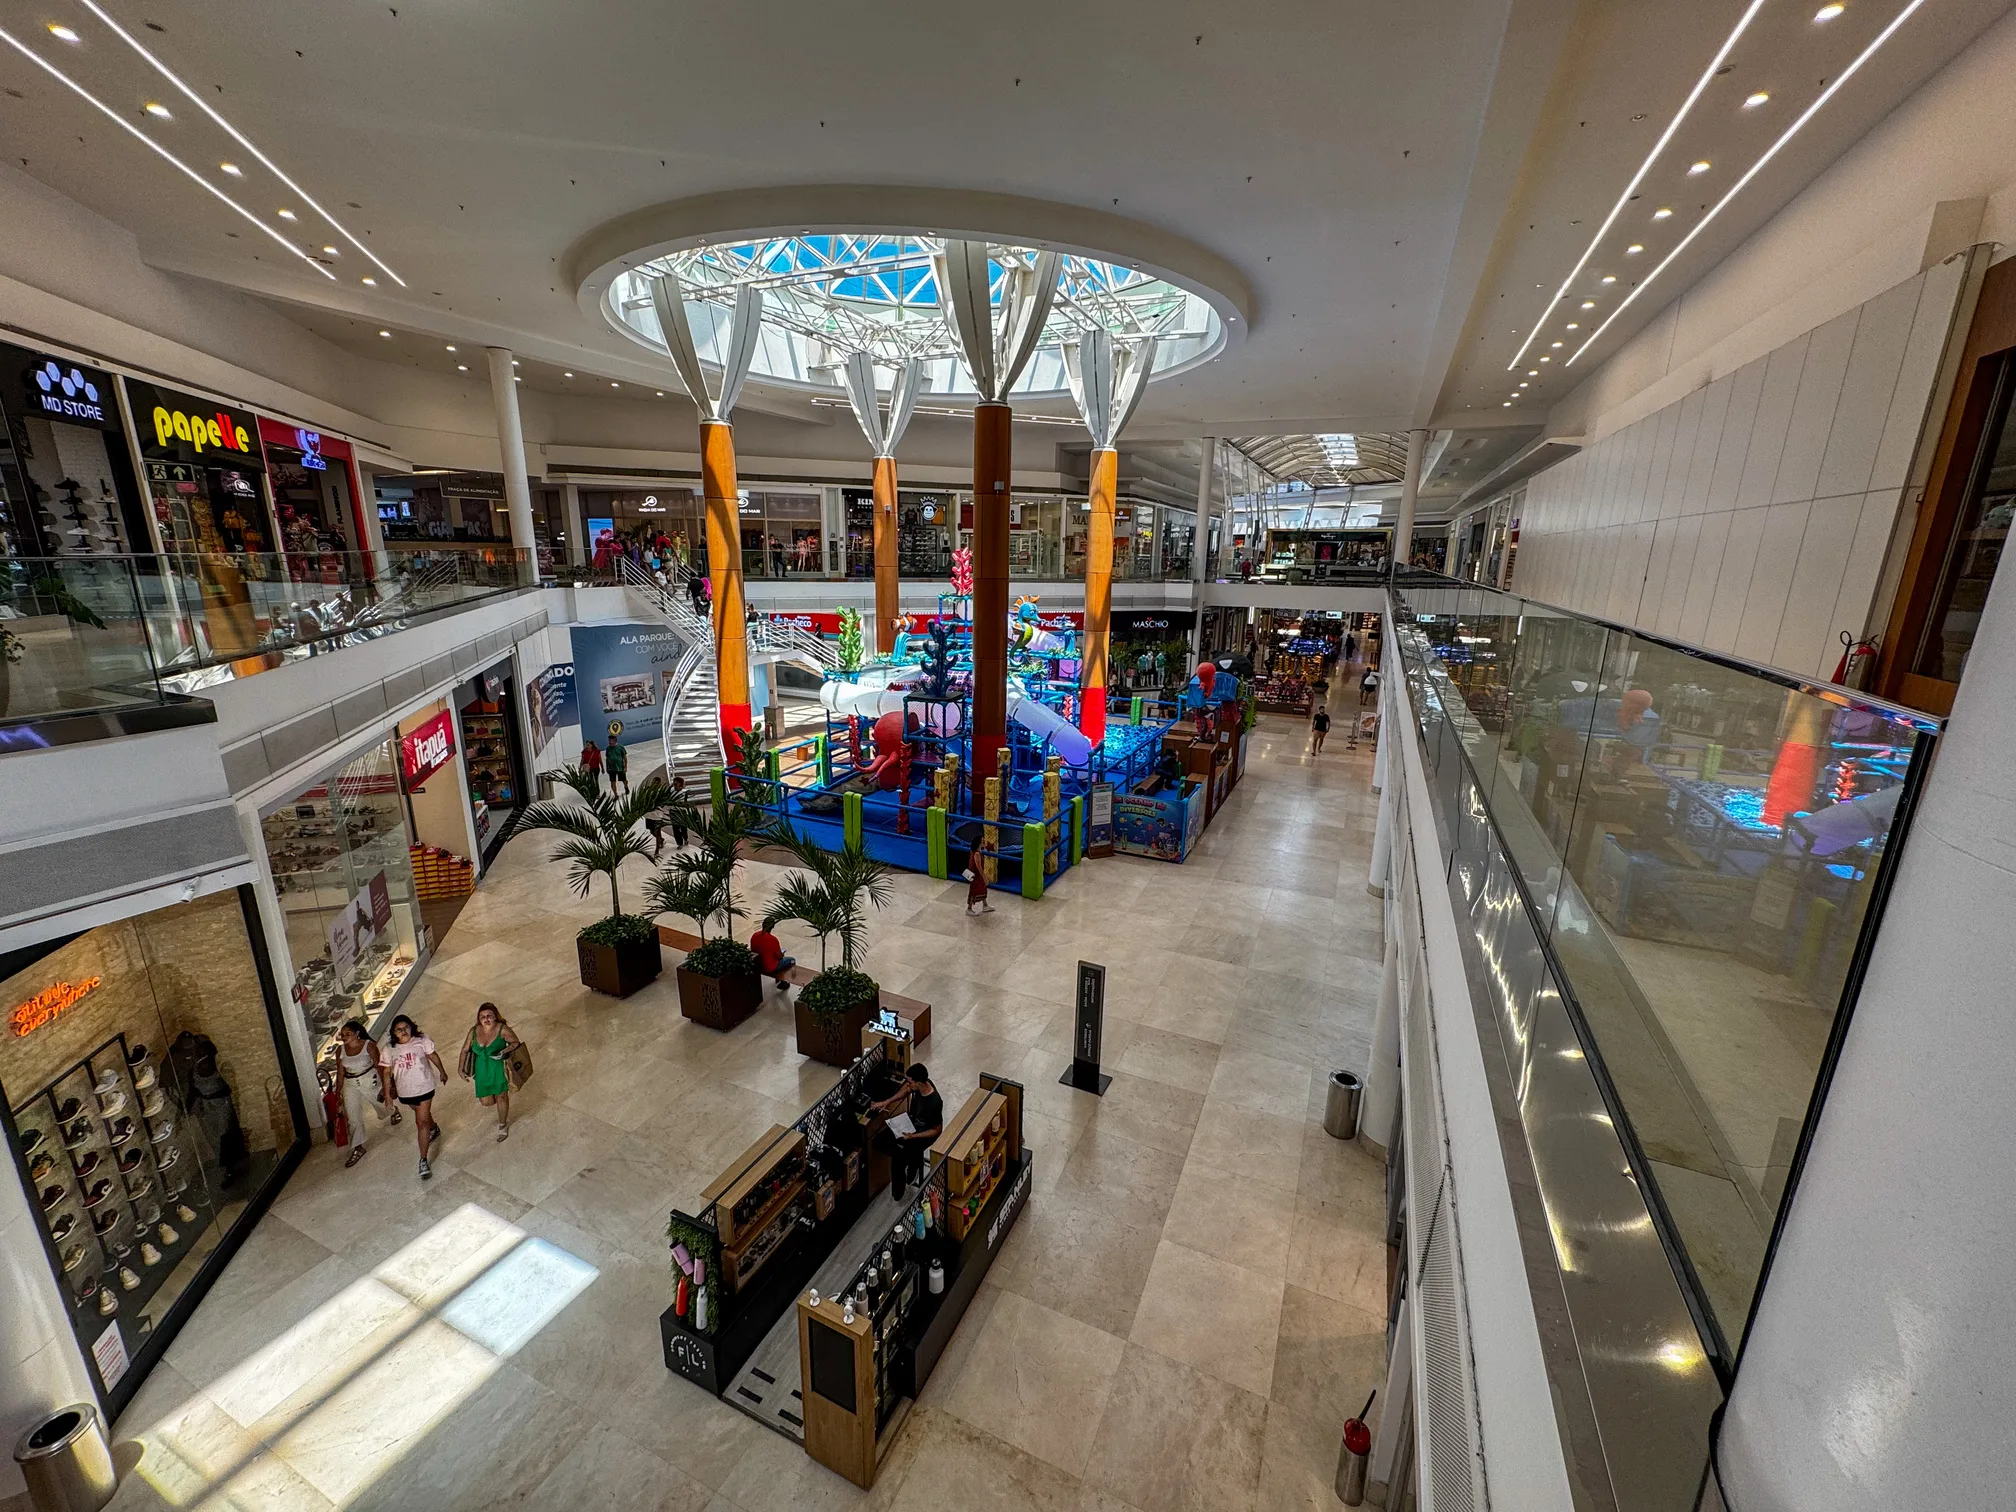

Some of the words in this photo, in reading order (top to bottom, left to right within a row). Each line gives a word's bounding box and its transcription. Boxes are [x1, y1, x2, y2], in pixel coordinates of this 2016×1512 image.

[41, 394, 61, 412] MD
[63, 400, 104, 421] STORE
[153, 406, 249, 453] papelle
[1132, 619, 1169, 629] MASCHIO
[620, 635, 638, 645] ALA
[636, 644, 655, 654] COM
[651, 643, 682, 664] aind
[413, 722, 447, 769] itapuã
[20, 975, 101, 1037] everywhere
